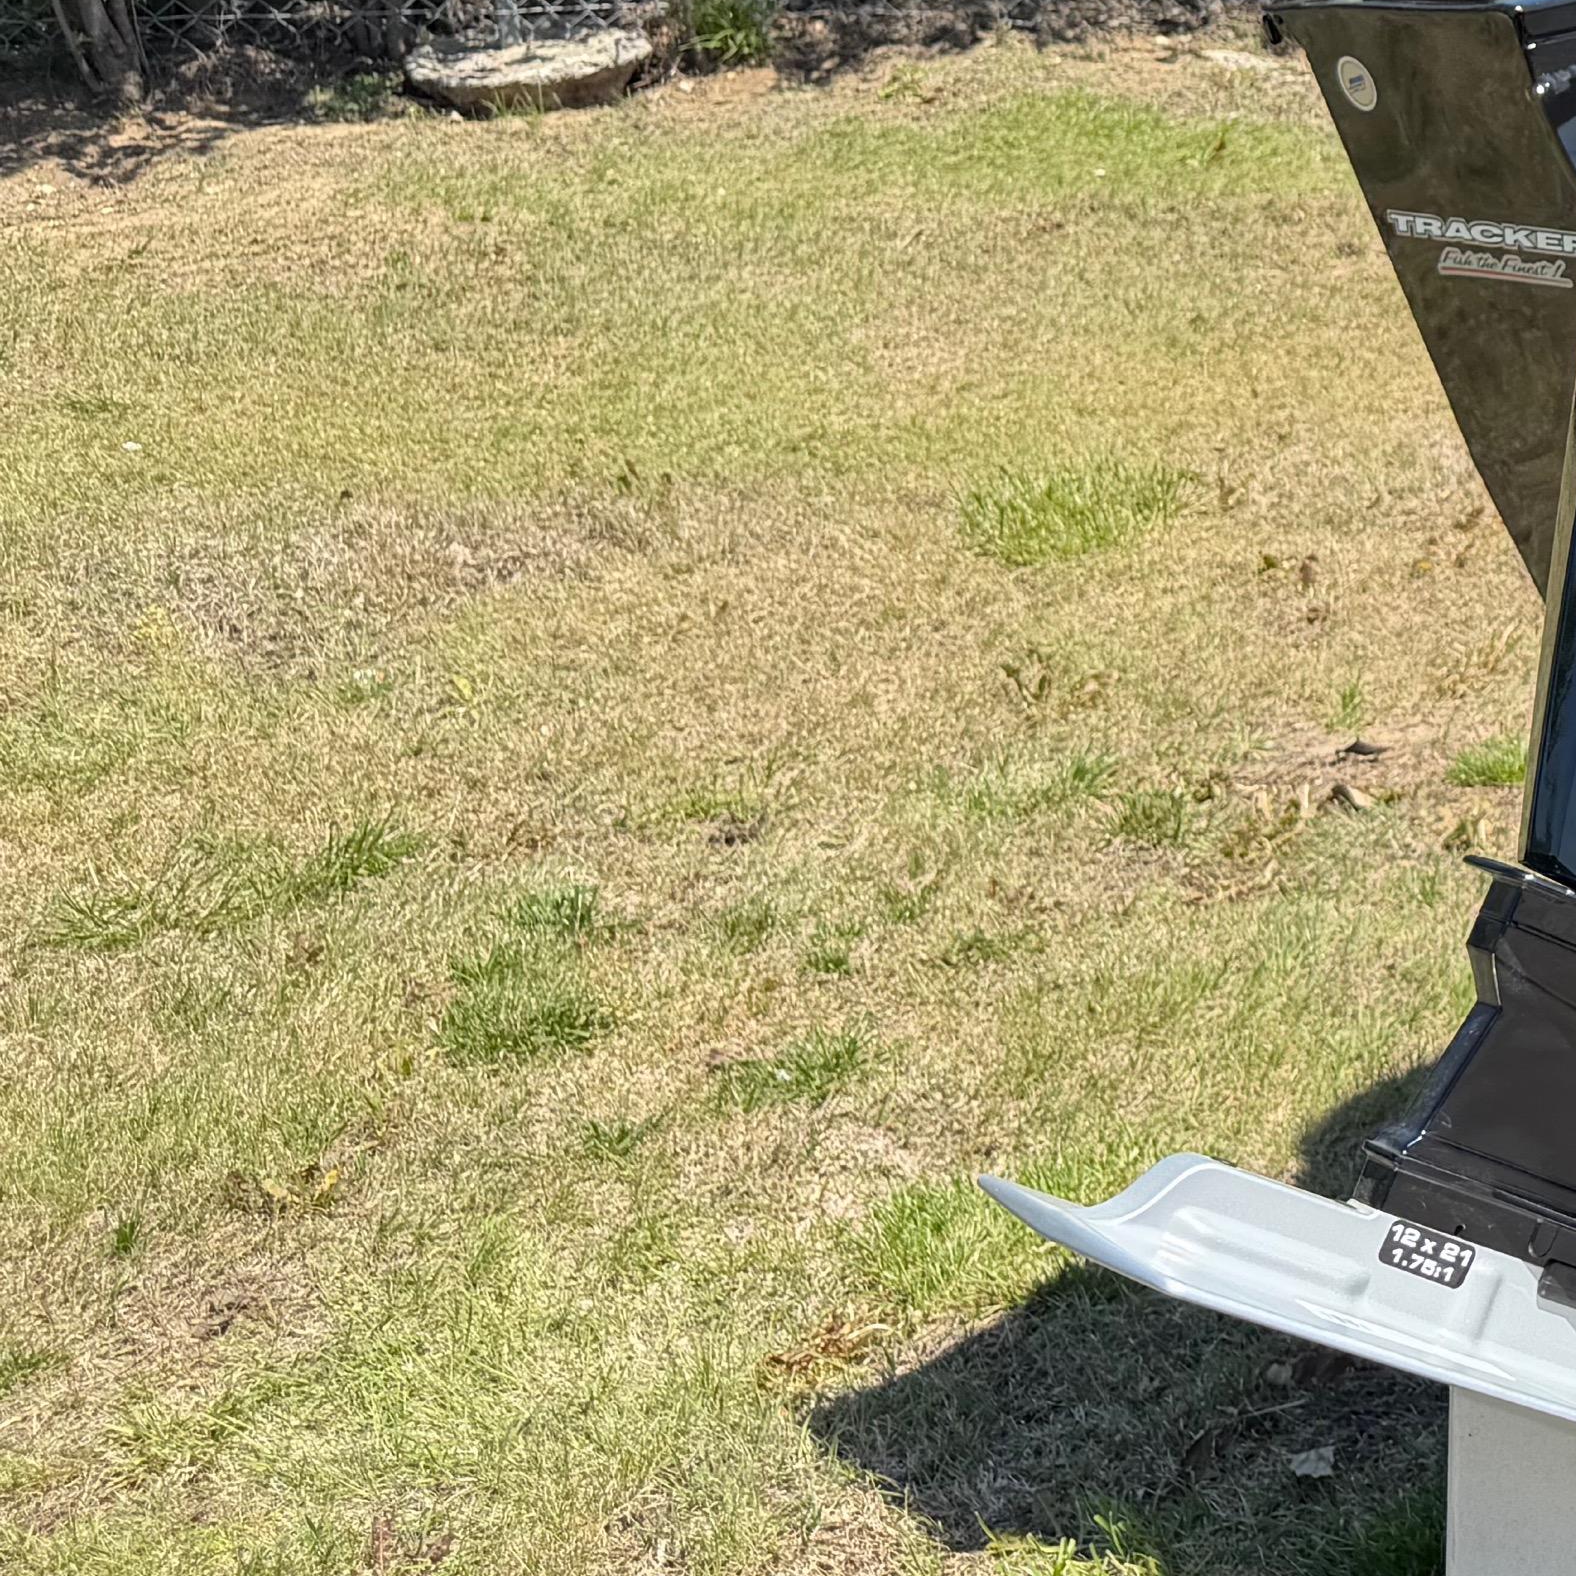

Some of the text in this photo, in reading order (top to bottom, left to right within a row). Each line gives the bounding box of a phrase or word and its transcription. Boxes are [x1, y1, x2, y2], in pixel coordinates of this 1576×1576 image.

[1475, 254, 1499, 270] the
[1391, 1224, 1421, 1248] 12
[1439, 1242, 1473, 1267] 21
